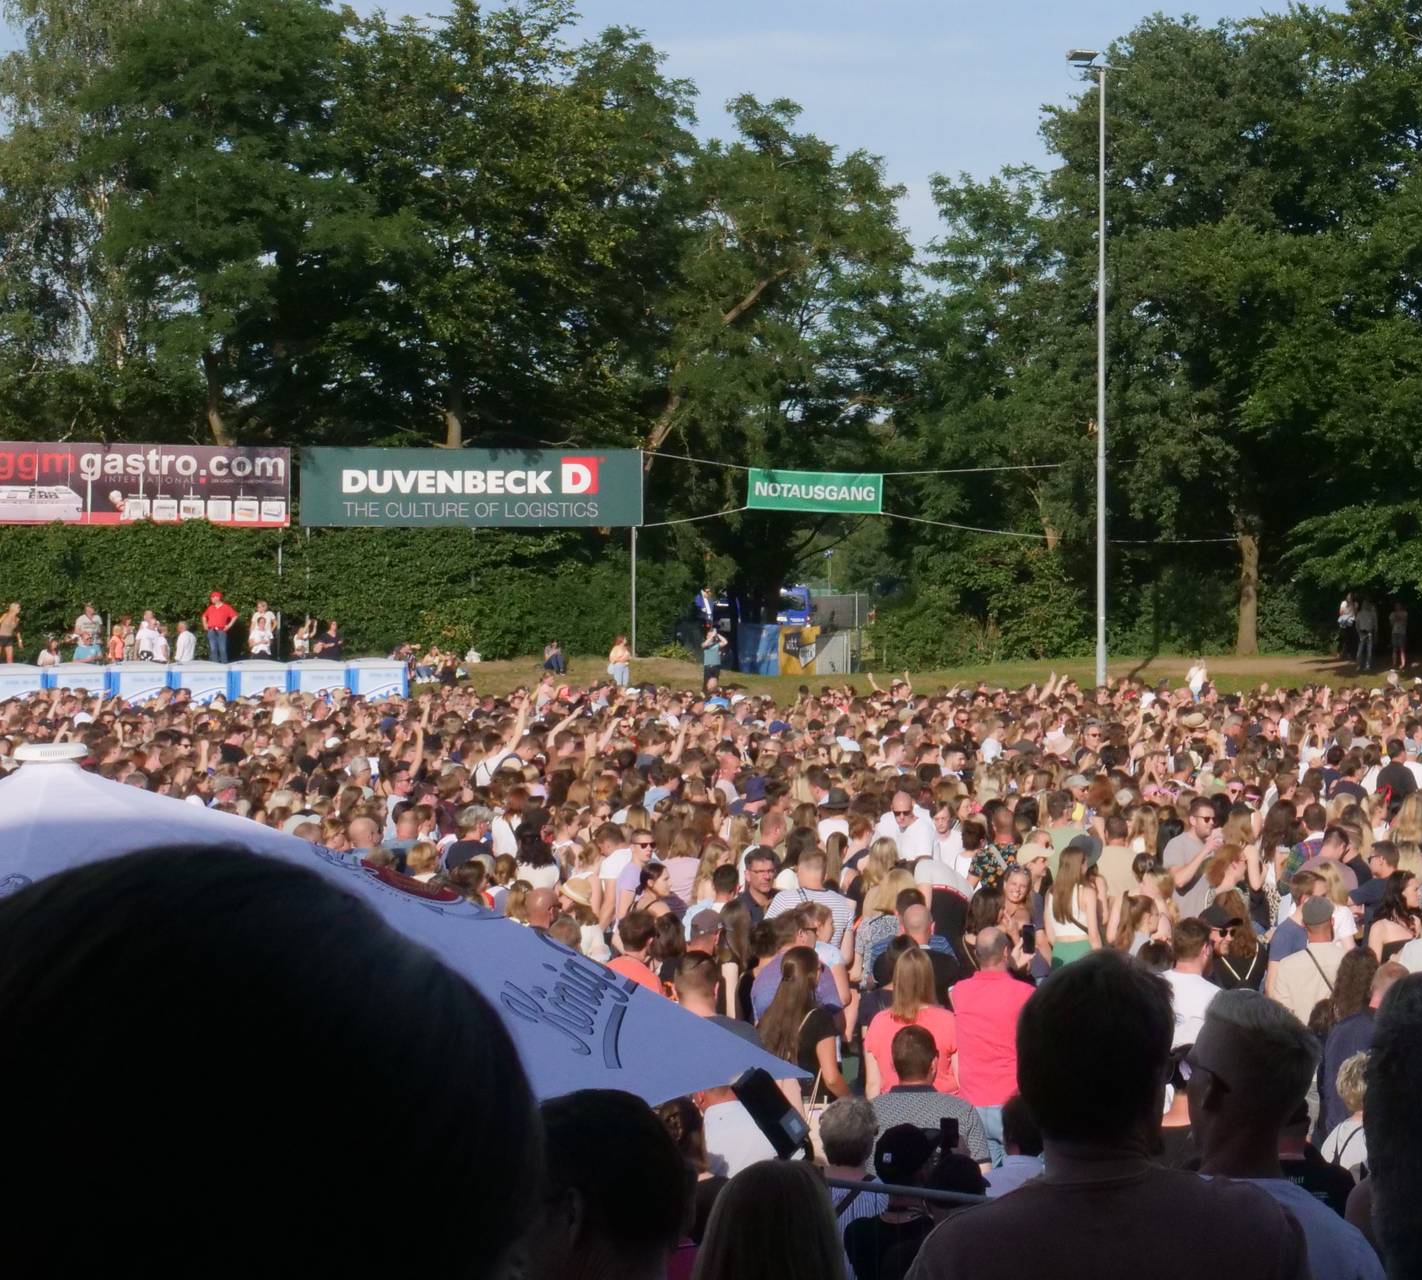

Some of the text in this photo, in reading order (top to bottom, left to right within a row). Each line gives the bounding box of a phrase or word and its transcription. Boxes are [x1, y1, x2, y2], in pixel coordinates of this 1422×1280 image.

[341, 469, 553, 494] DUVENBECK
[754, 481, 875, 501] NOTAUSGANG
[343, 501, 599, 518] THE CULTURE OF LOGISTICS
